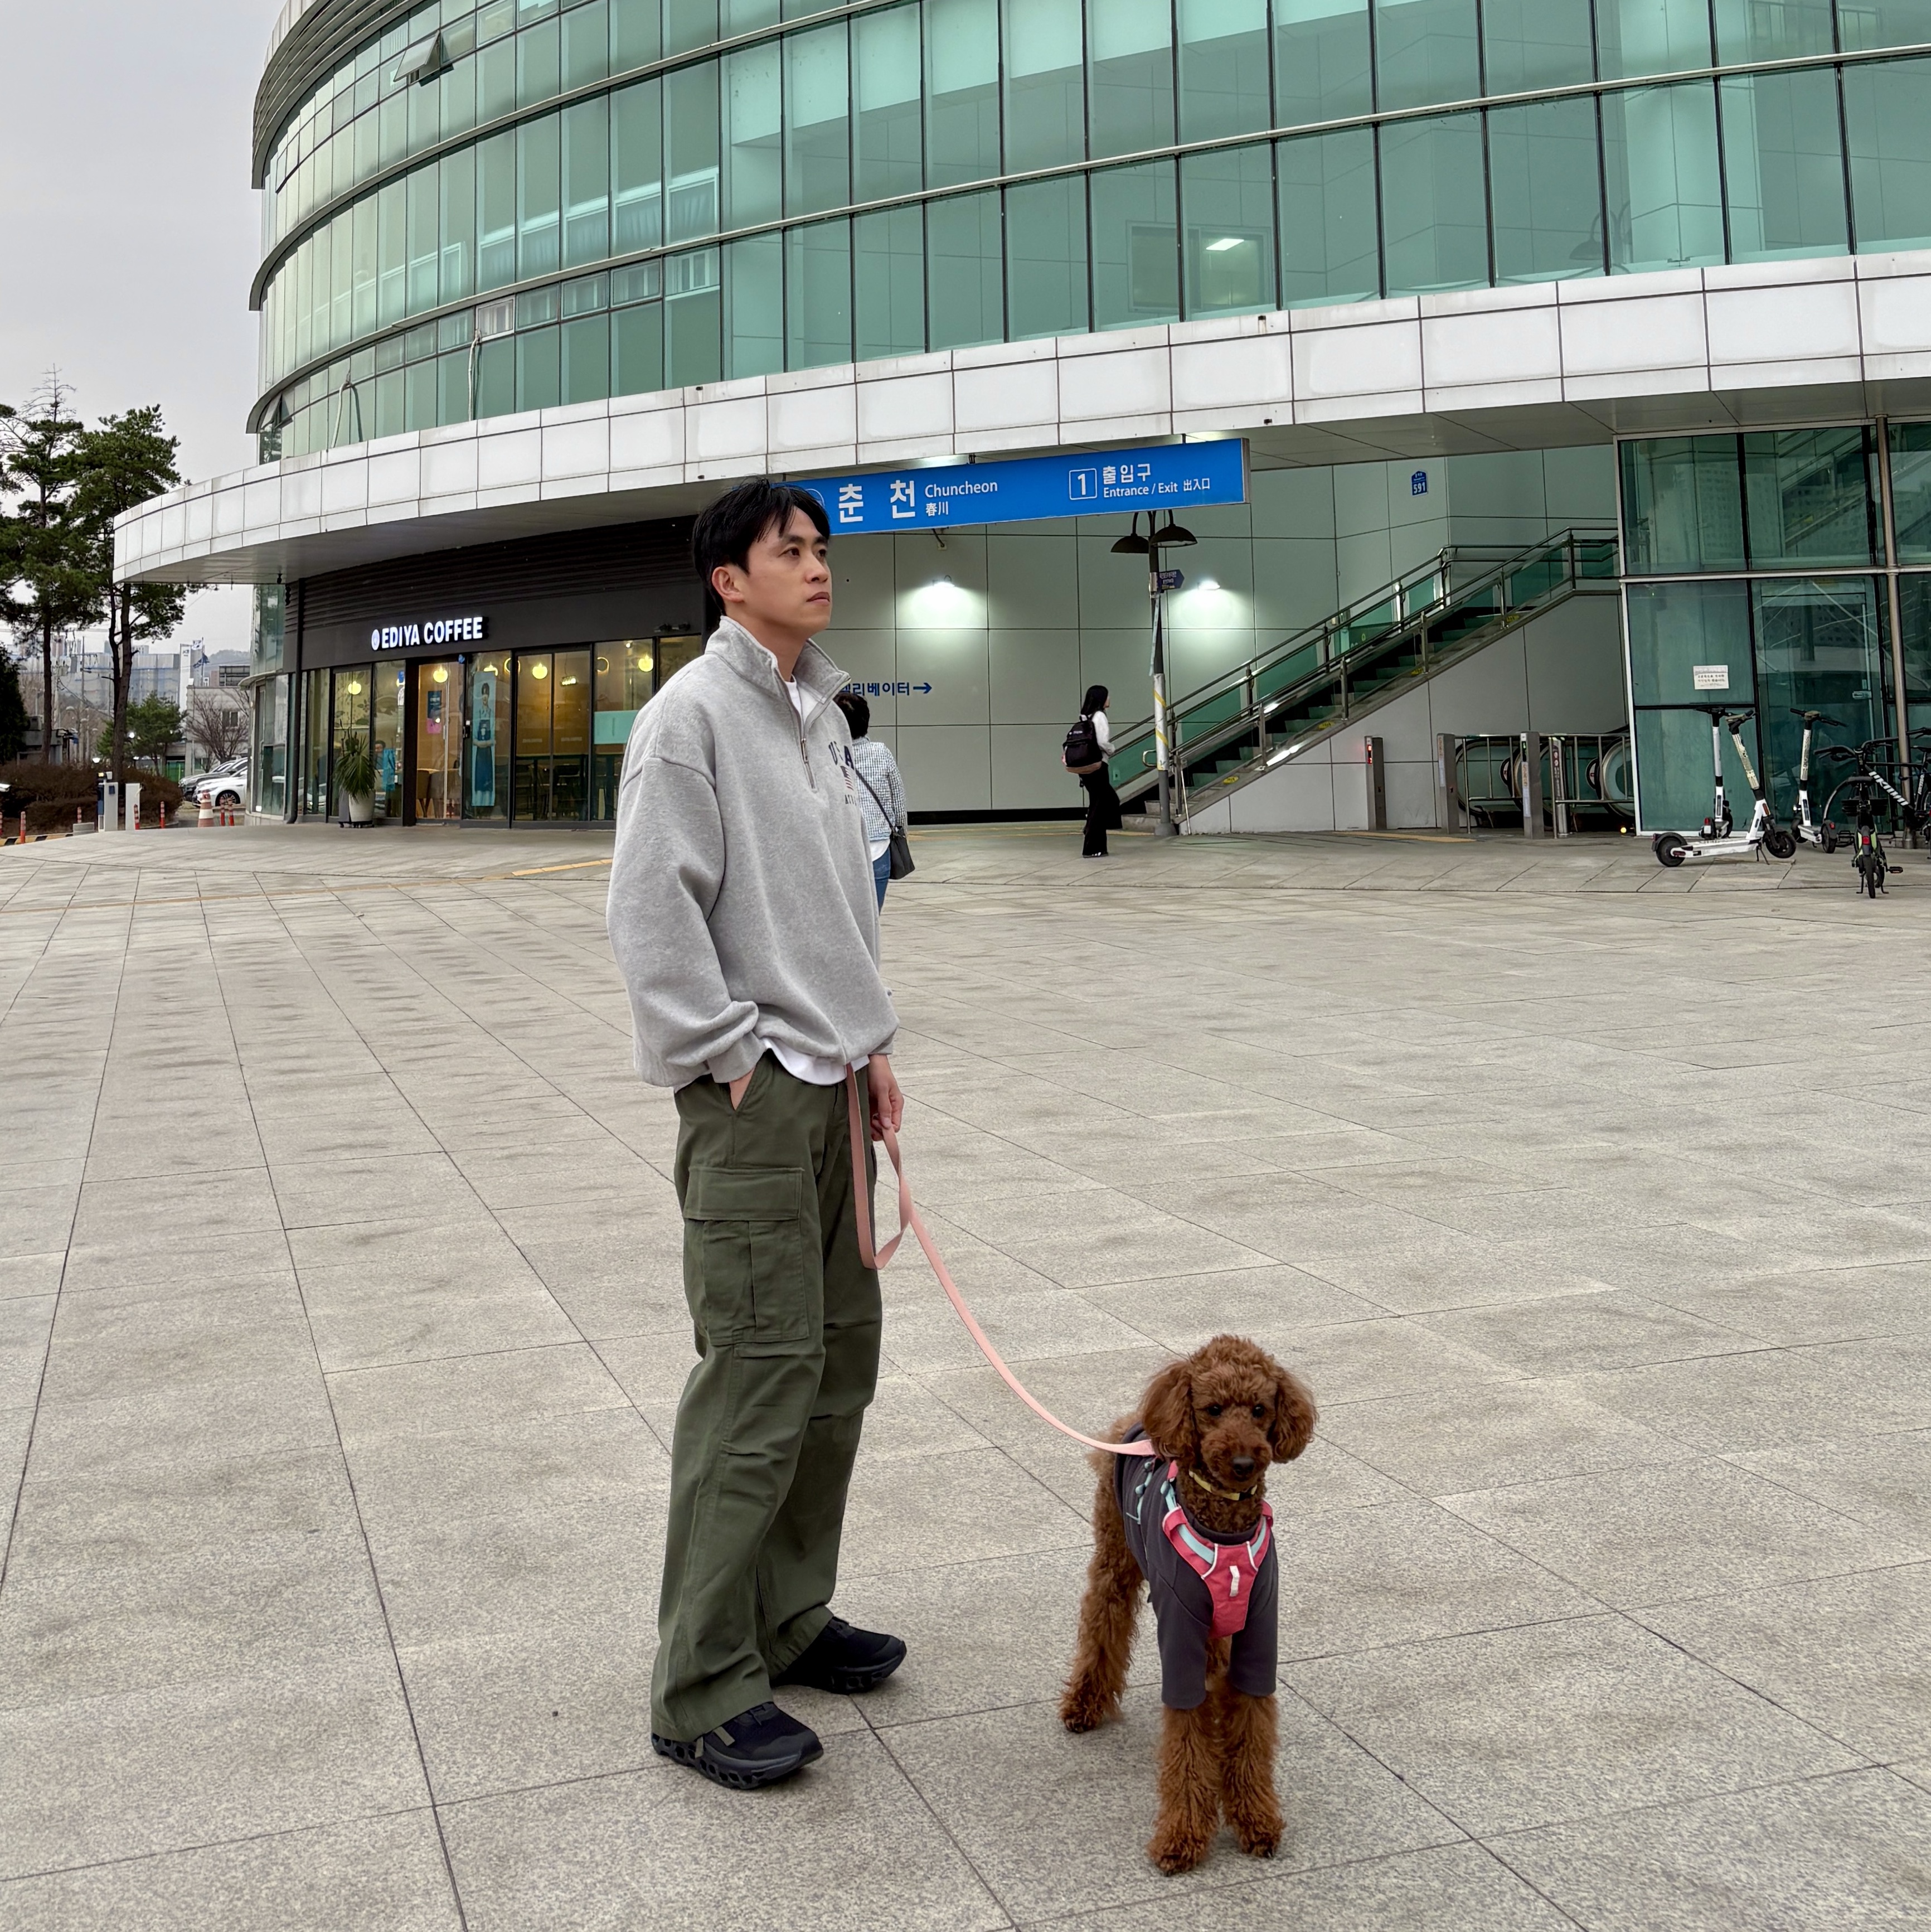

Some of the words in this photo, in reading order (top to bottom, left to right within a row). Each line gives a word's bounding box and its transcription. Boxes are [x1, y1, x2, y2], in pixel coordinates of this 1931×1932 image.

[1103, 463, 1151, 485] 출입구
[924, 481, 998, 498] Chuncheon
[1077, 473, 1086, 496] 1
[1103, 486, 1149, 498] Entrance
[1158, 482, 1178, 493] Exit
[1183, 478, 1210, 492] 出入口
[1413, 482, 1425, 494] 591
[925, 501, 949, 517] 春川
[381, 624, 420, 649] EDIYA
[424, 617, 483, 645] COFFEE
